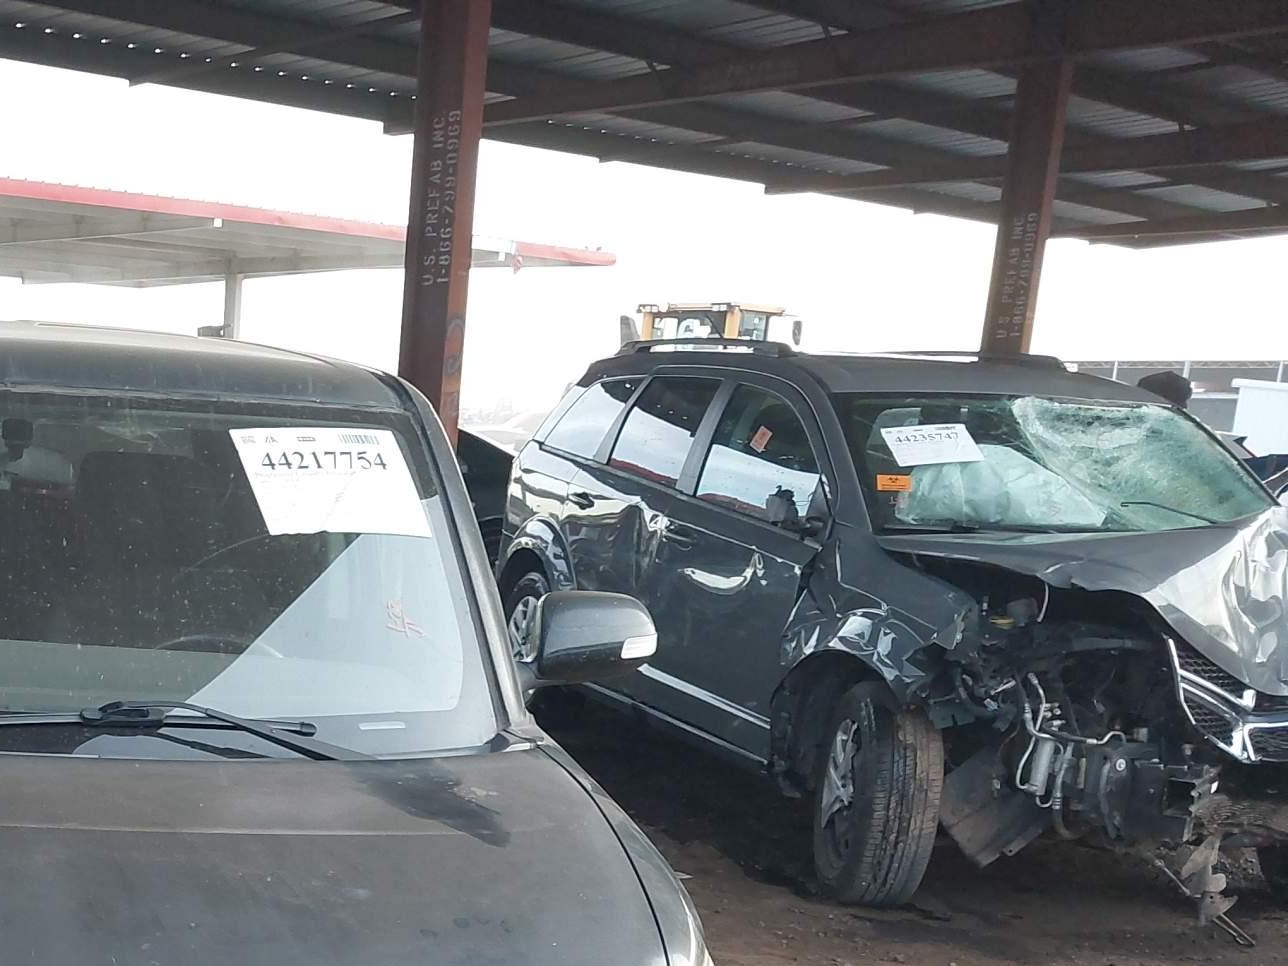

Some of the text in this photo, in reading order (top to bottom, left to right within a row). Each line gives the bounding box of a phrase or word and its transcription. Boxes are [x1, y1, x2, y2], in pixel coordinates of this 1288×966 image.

[424, 159, 443, 237] PREFAB
[435, 109, 461, 284] 1-866-799-0969
[261, 451, 388, 471] 44217754
[894, 432, 960, 444] 44235747
